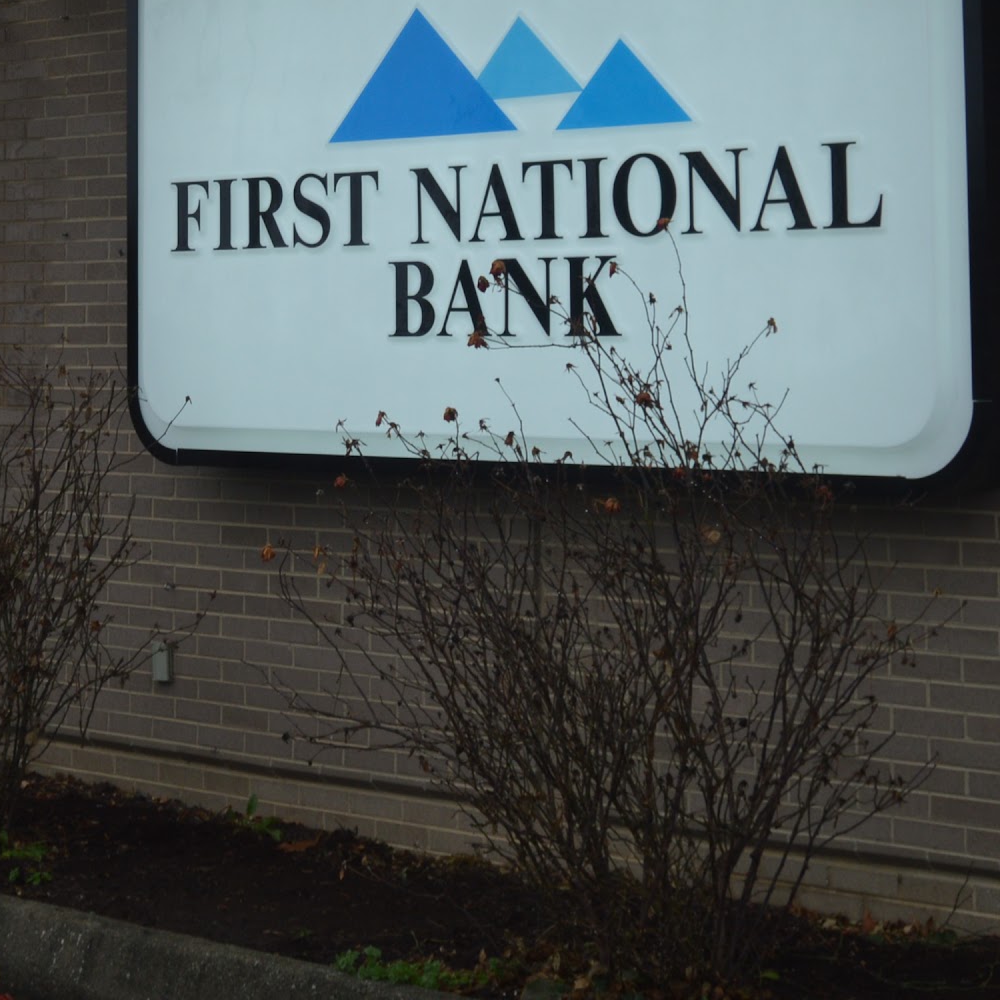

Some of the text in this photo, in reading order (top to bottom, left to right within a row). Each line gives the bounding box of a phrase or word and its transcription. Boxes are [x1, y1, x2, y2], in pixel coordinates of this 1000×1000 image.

[171, 142, 883, 252] FIRST NATIONAL
[388, 255, 622, 338] BANK
